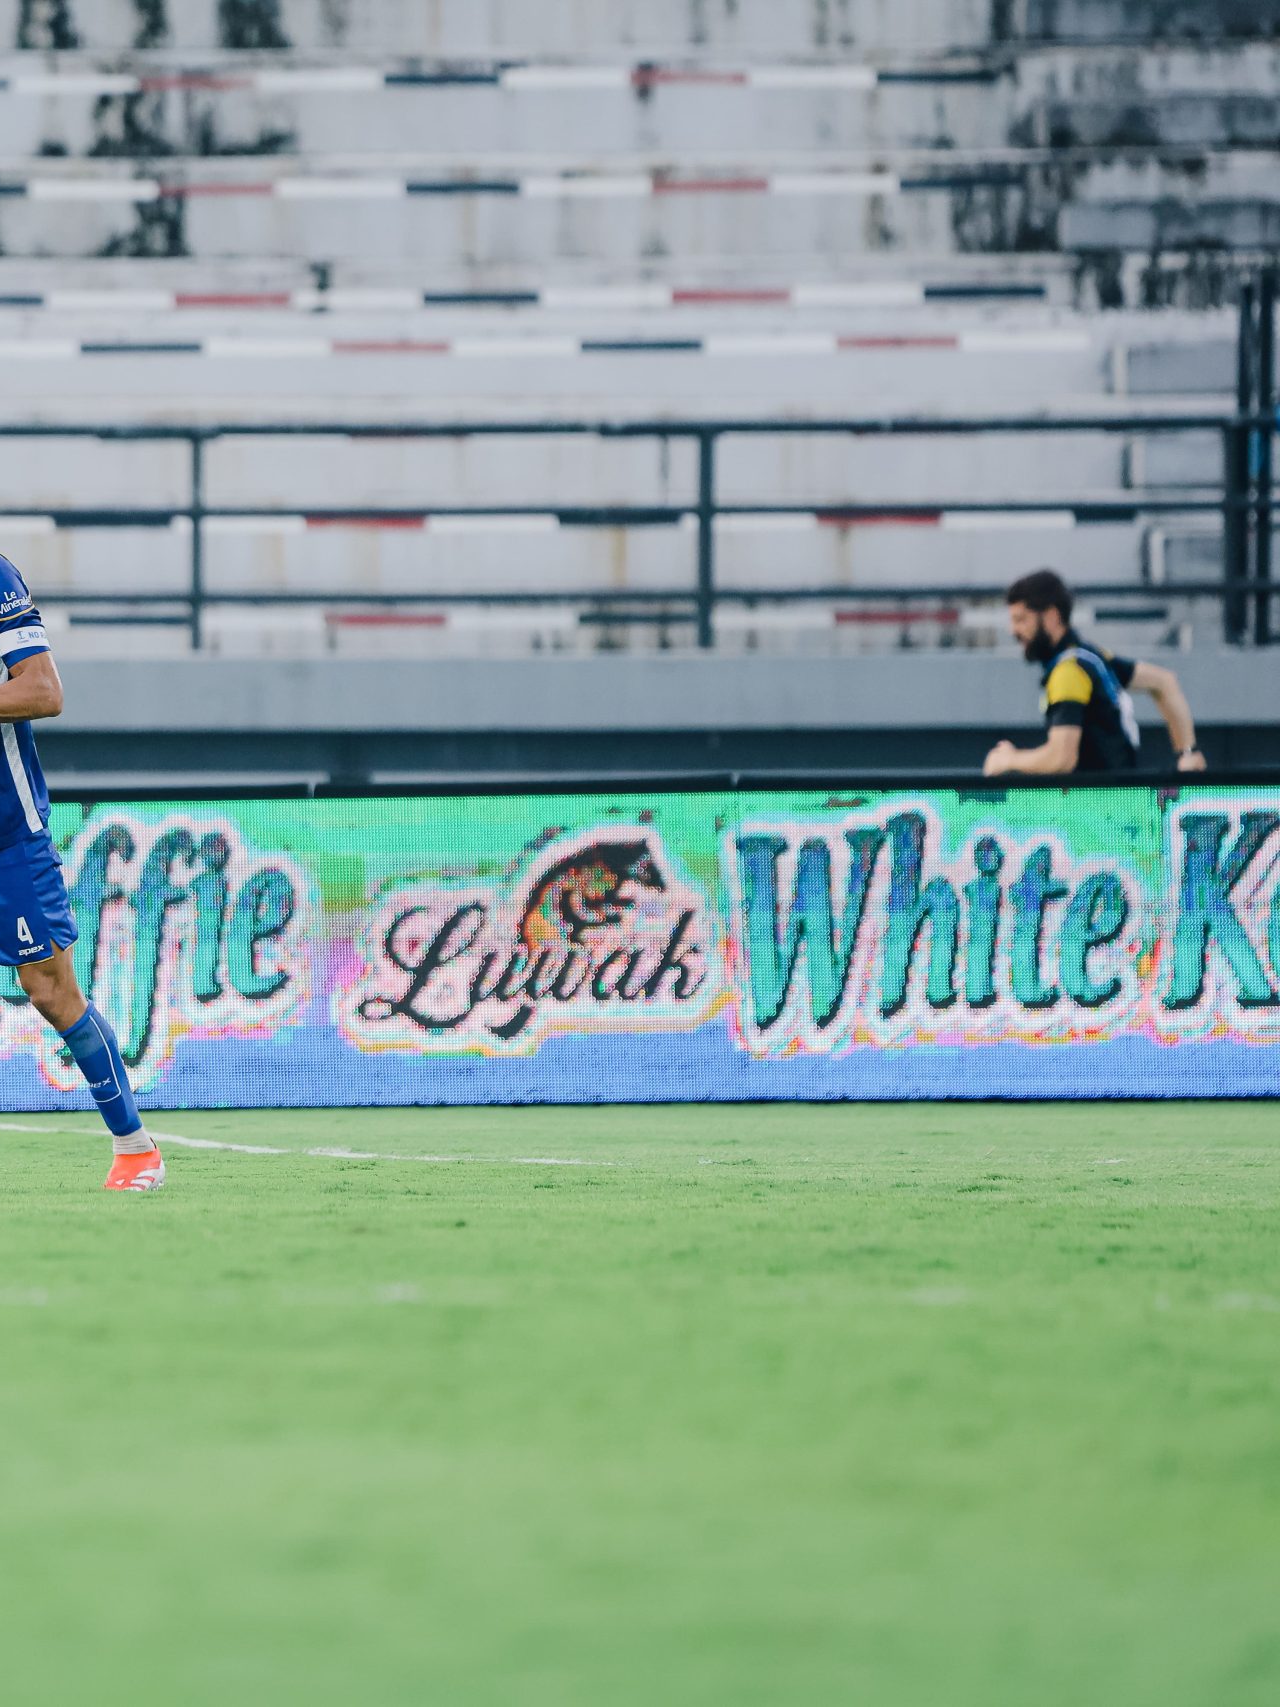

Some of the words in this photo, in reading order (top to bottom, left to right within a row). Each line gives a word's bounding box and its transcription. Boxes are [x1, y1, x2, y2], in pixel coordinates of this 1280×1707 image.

[3, 591, 18, 602] Le
[16, 916, 34, 945] 4
[357, 900, 708, 1041] Luwak
[735, 811, 1131, 1031] White
[1163, 811, 1280, 1012] K
[18, 943, 45, 957] apex
